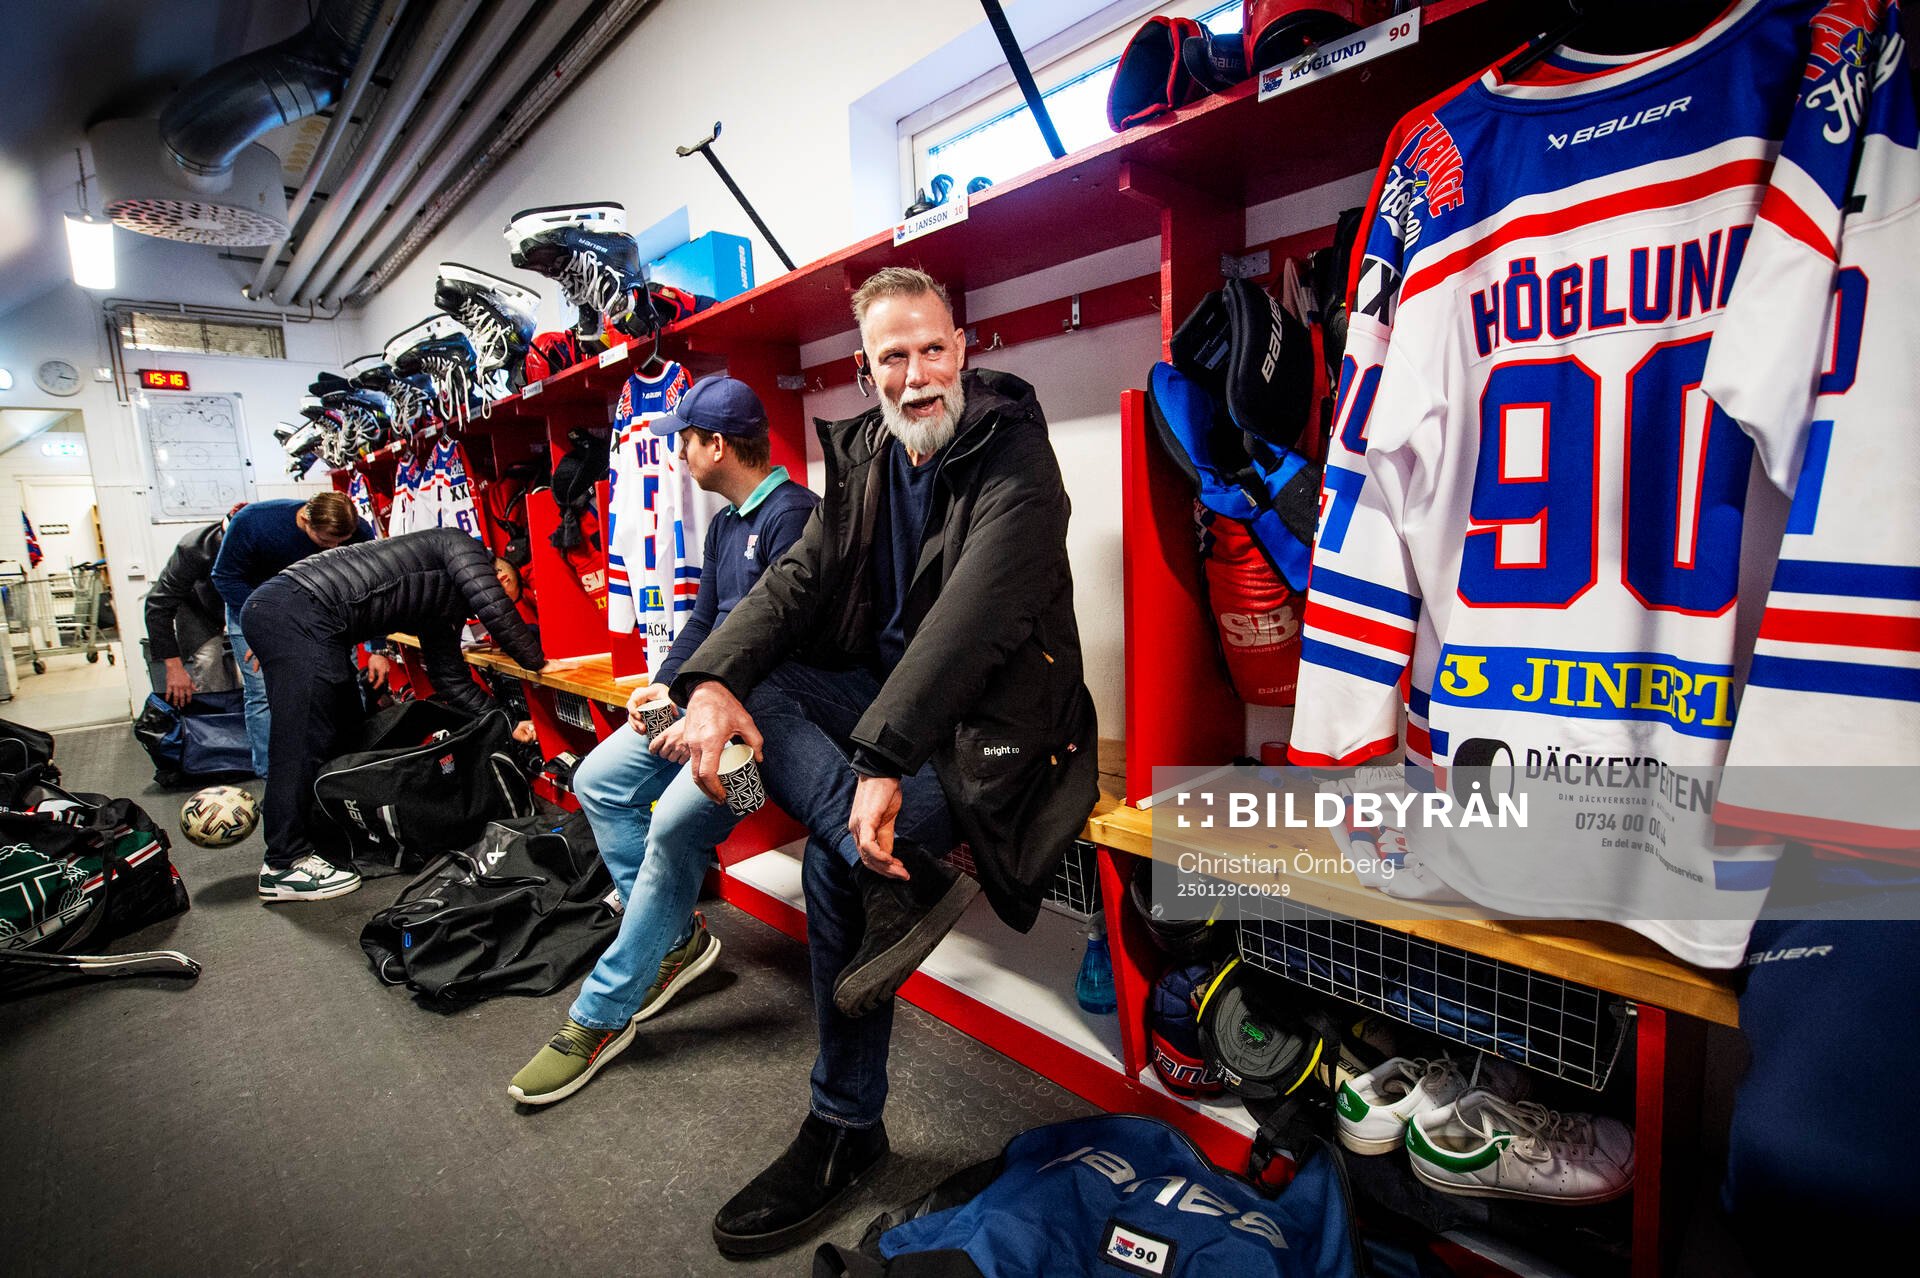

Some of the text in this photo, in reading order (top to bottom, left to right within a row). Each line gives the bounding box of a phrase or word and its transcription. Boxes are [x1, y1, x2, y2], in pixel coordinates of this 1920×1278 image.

[1389, 22, 1411, 42] 90
[149, 372, 184, 387] 15:16
[1457, 331, 1756, 619] 90
[1511, 657, 1735, 729] JINERT
[983, 745, 1011, 757] Bright
[1575, 812, 1617, 831] 0734
[1601, 838, 1613, 848] En
[1615, 839, 1629, 849] del
[1631, 841, 1643, 851] av
[1744, 945, 1834, 967] AUER
[1134, 1247, 1158, 1264] 90
